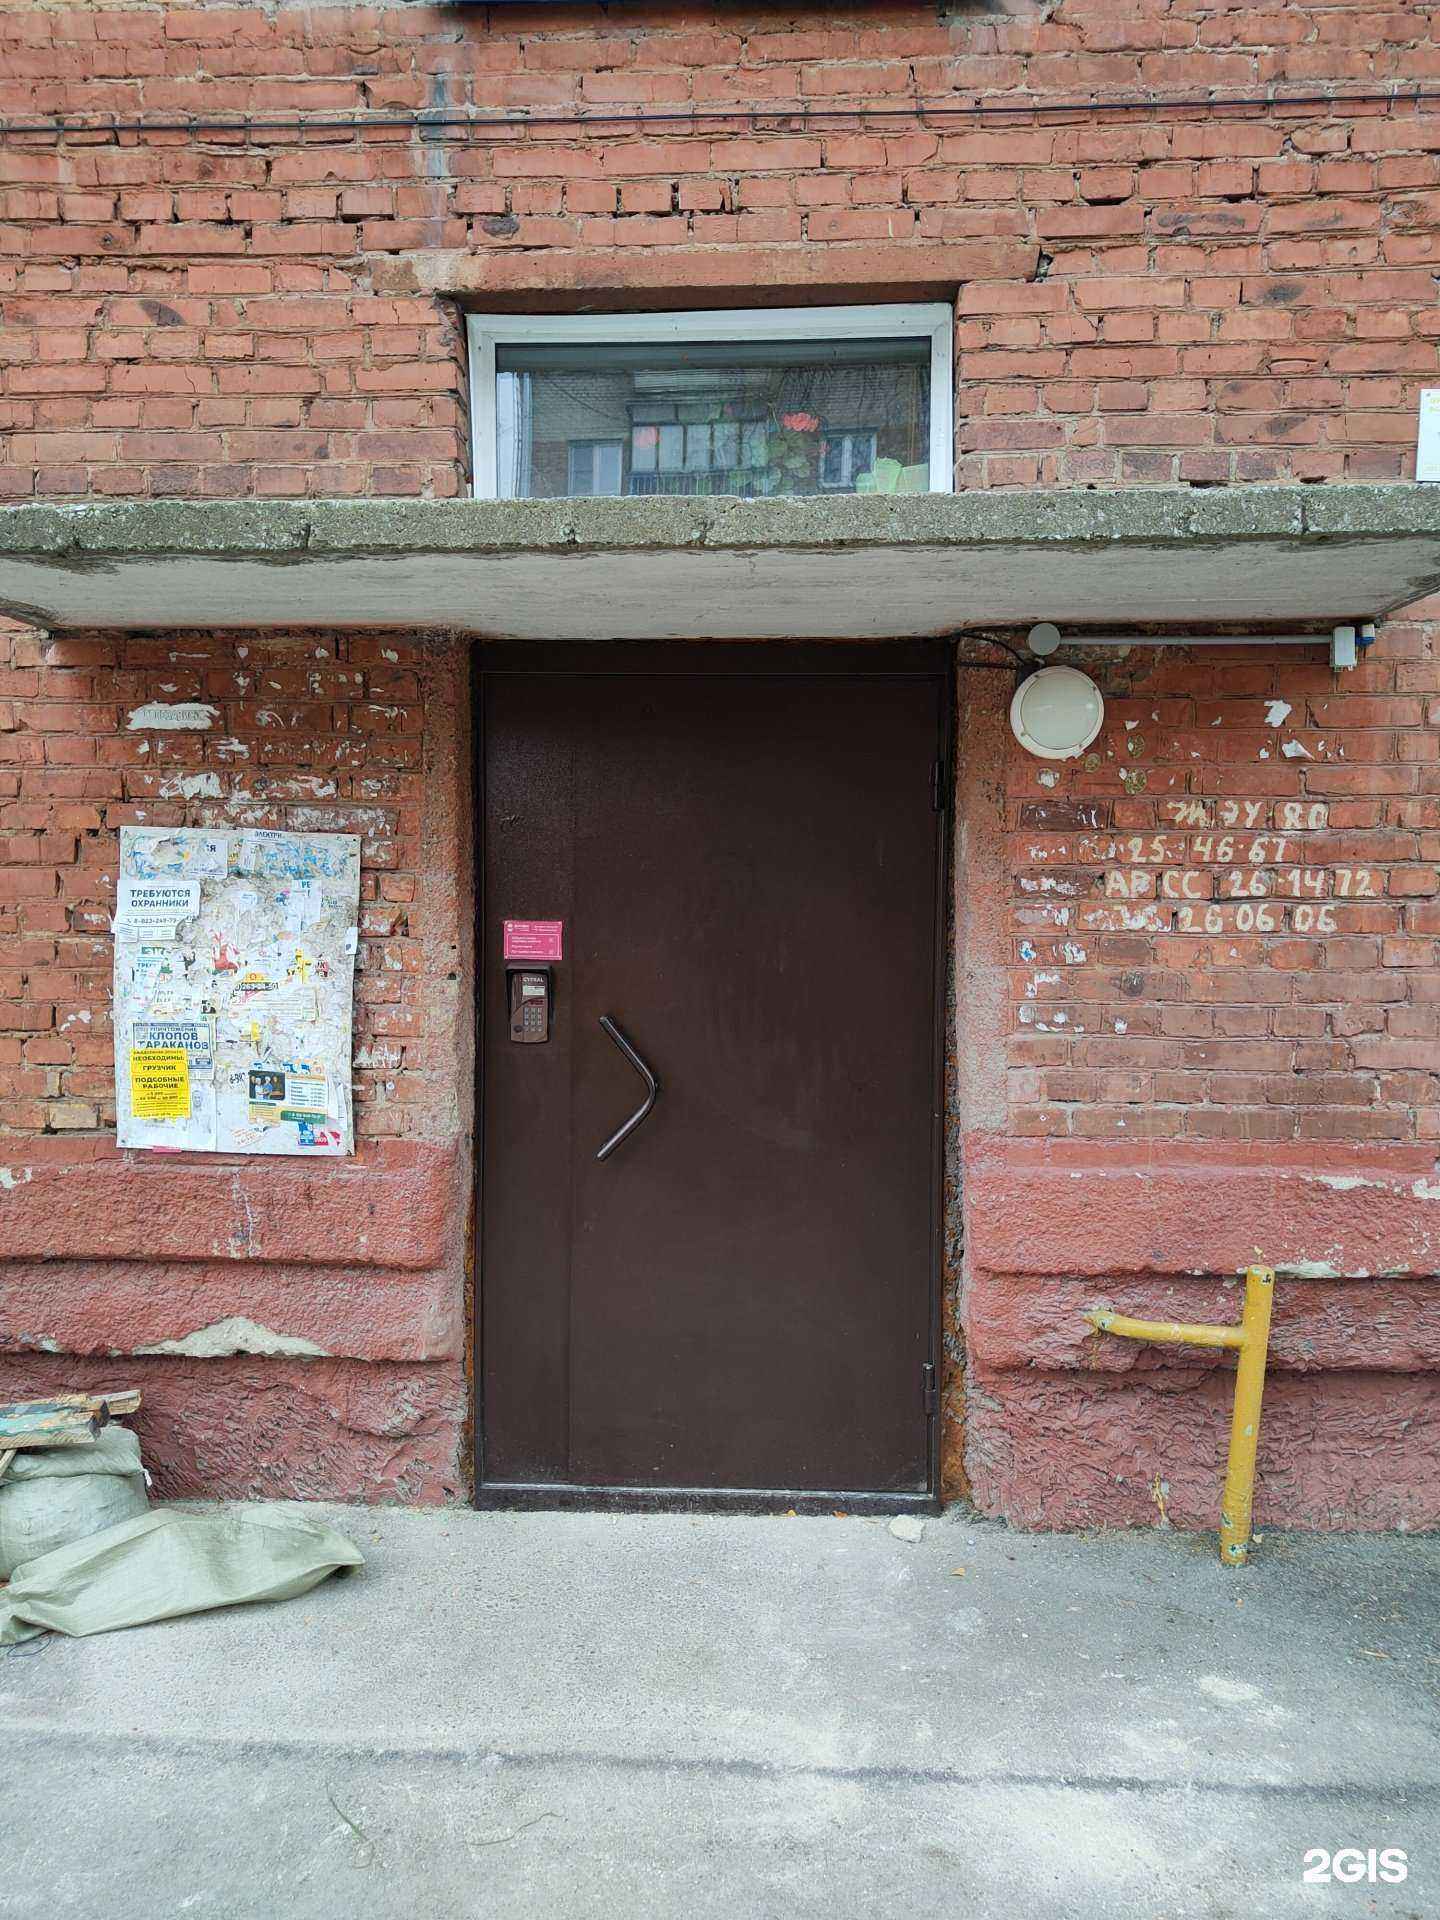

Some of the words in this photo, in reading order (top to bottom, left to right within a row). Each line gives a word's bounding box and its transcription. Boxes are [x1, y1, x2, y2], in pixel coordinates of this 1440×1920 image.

[130, 889, 191, 898] ТРЕБУЮТСЯ
[131, 899, 189, 908] ОХРАННИКИ
[149, 1032, 198, 1041] КЛОПОВ
